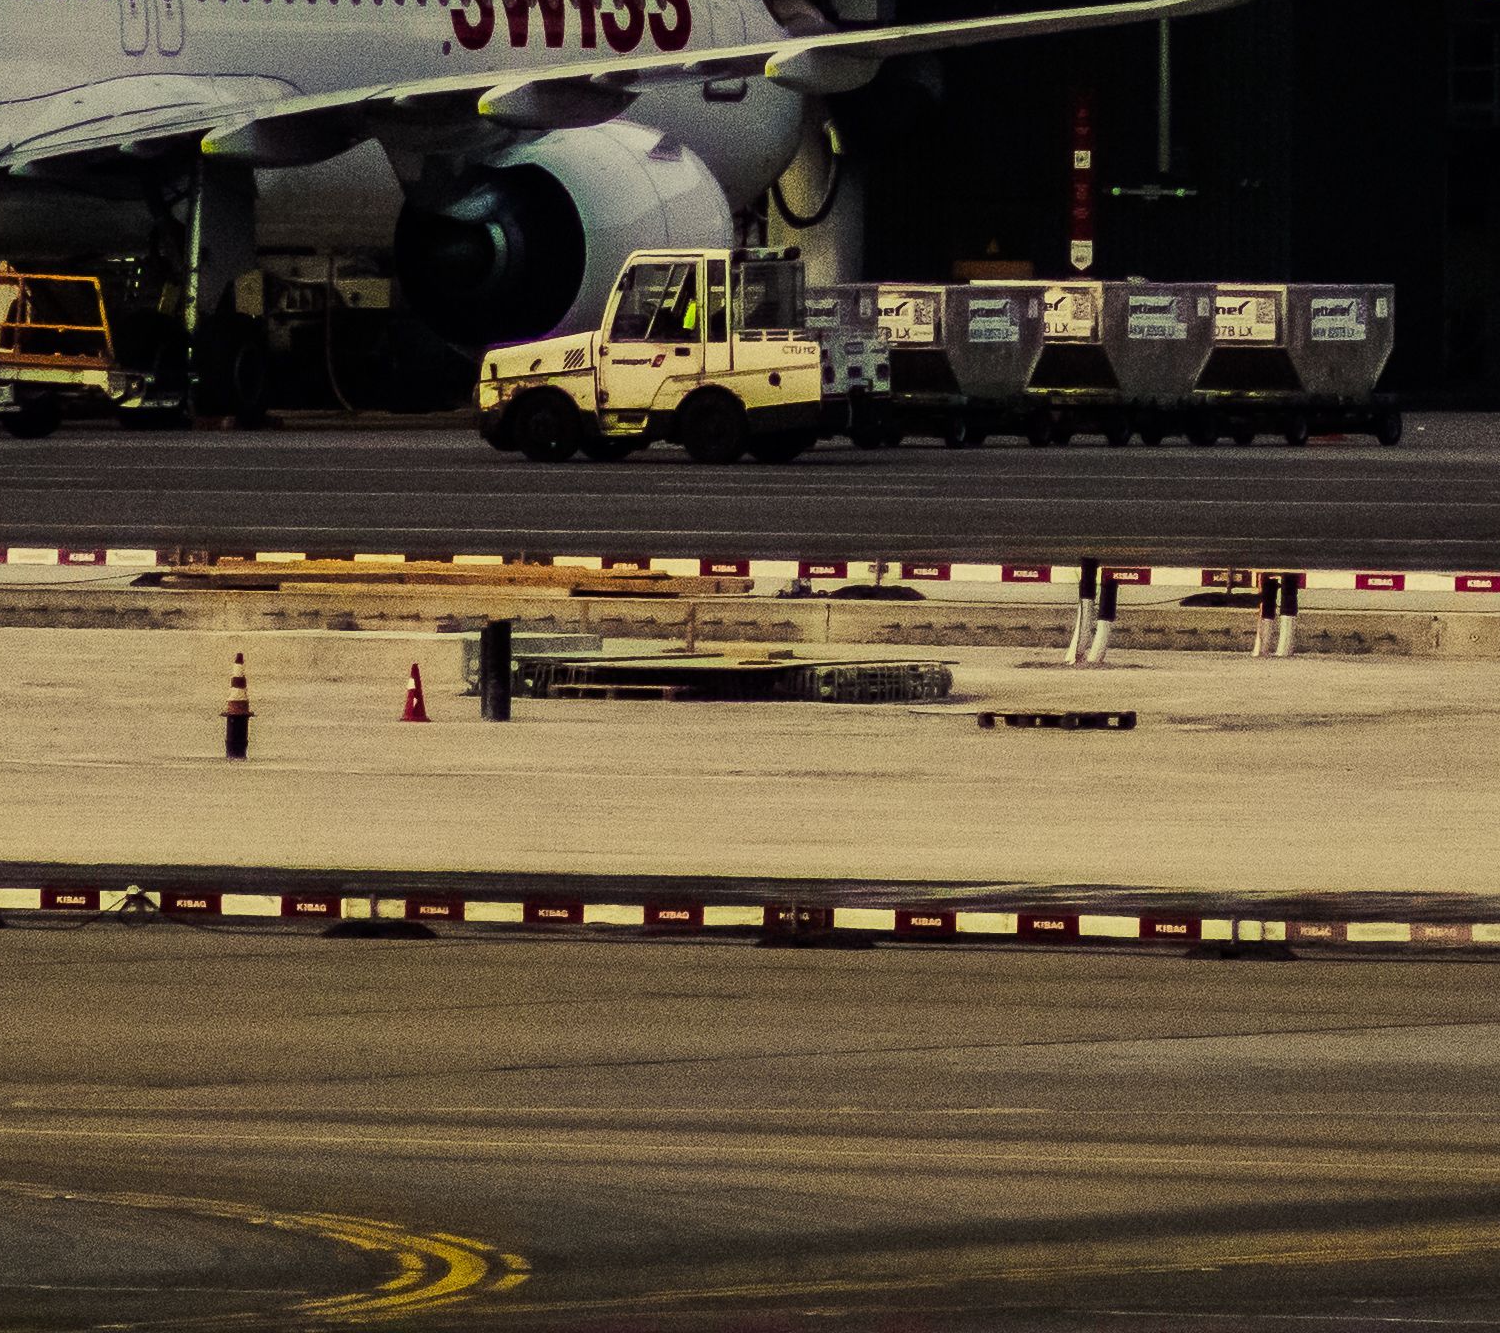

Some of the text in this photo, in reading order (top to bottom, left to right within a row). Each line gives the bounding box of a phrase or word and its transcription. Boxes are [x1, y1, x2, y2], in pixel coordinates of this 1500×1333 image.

[56, 896, 85, 905] KIBAG
[176, 899, 206, 908] KIBAG
[297, 903, 326, 912] KIBAG
[420, 906, 449, 915] KIBAG
[539, 909, 568, 917] KIBAG
[659, 911, 689, 920] KIBAG
[911, 917, 942, 926] KIBAG
[1033, 920, 1064, 930] KIBAG
[1155, 924, 1186, 934] KIBAG
